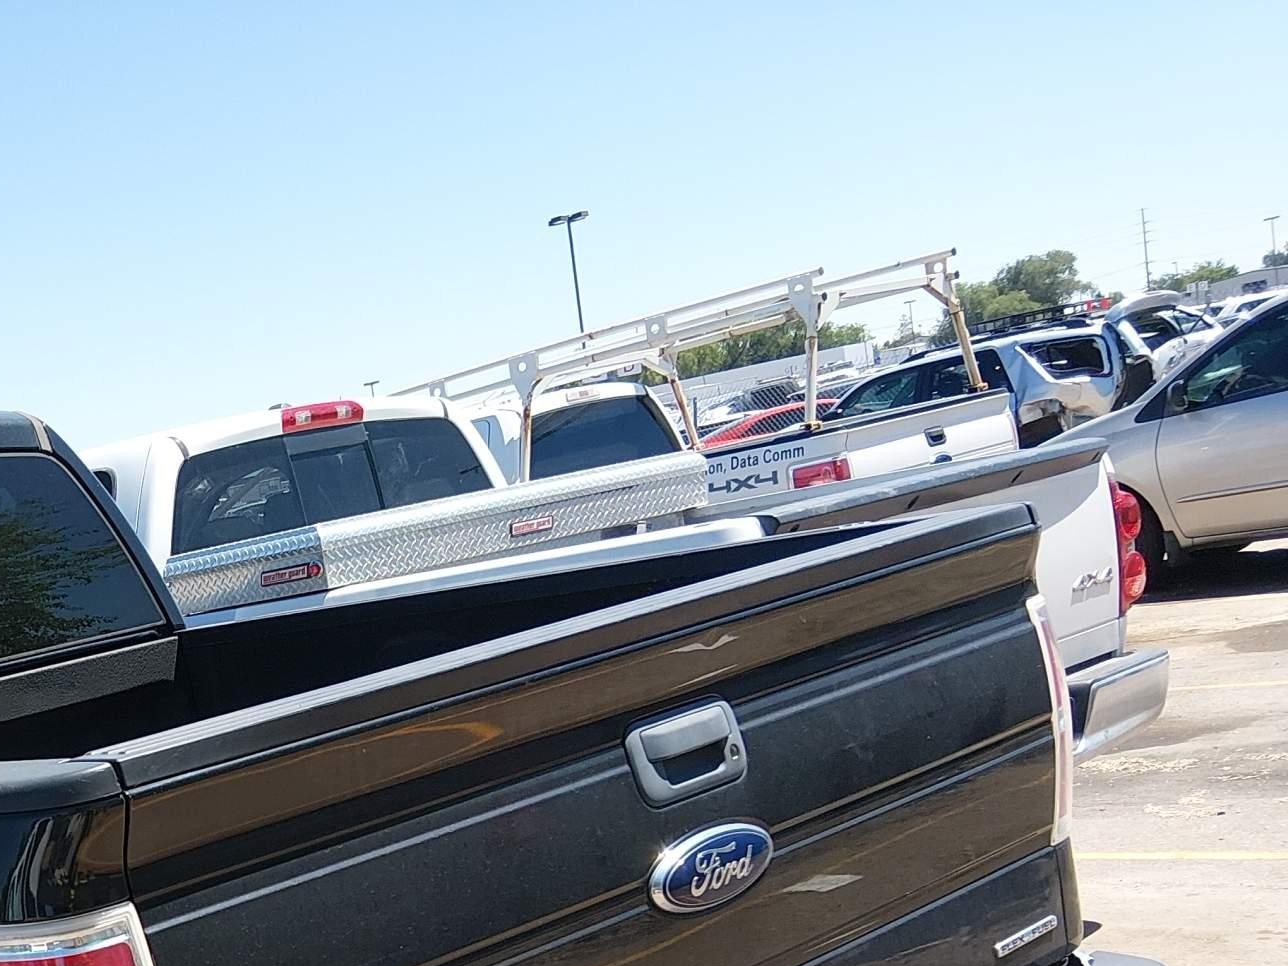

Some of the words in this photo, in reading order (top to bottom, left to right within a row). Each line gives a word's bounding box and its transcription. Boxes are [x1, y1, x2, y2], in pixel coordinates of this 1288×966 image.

[731, 456, 759, 470] Data
[763, 446, 805, 463] Comm
[691, 841, 754, 897] Ford
